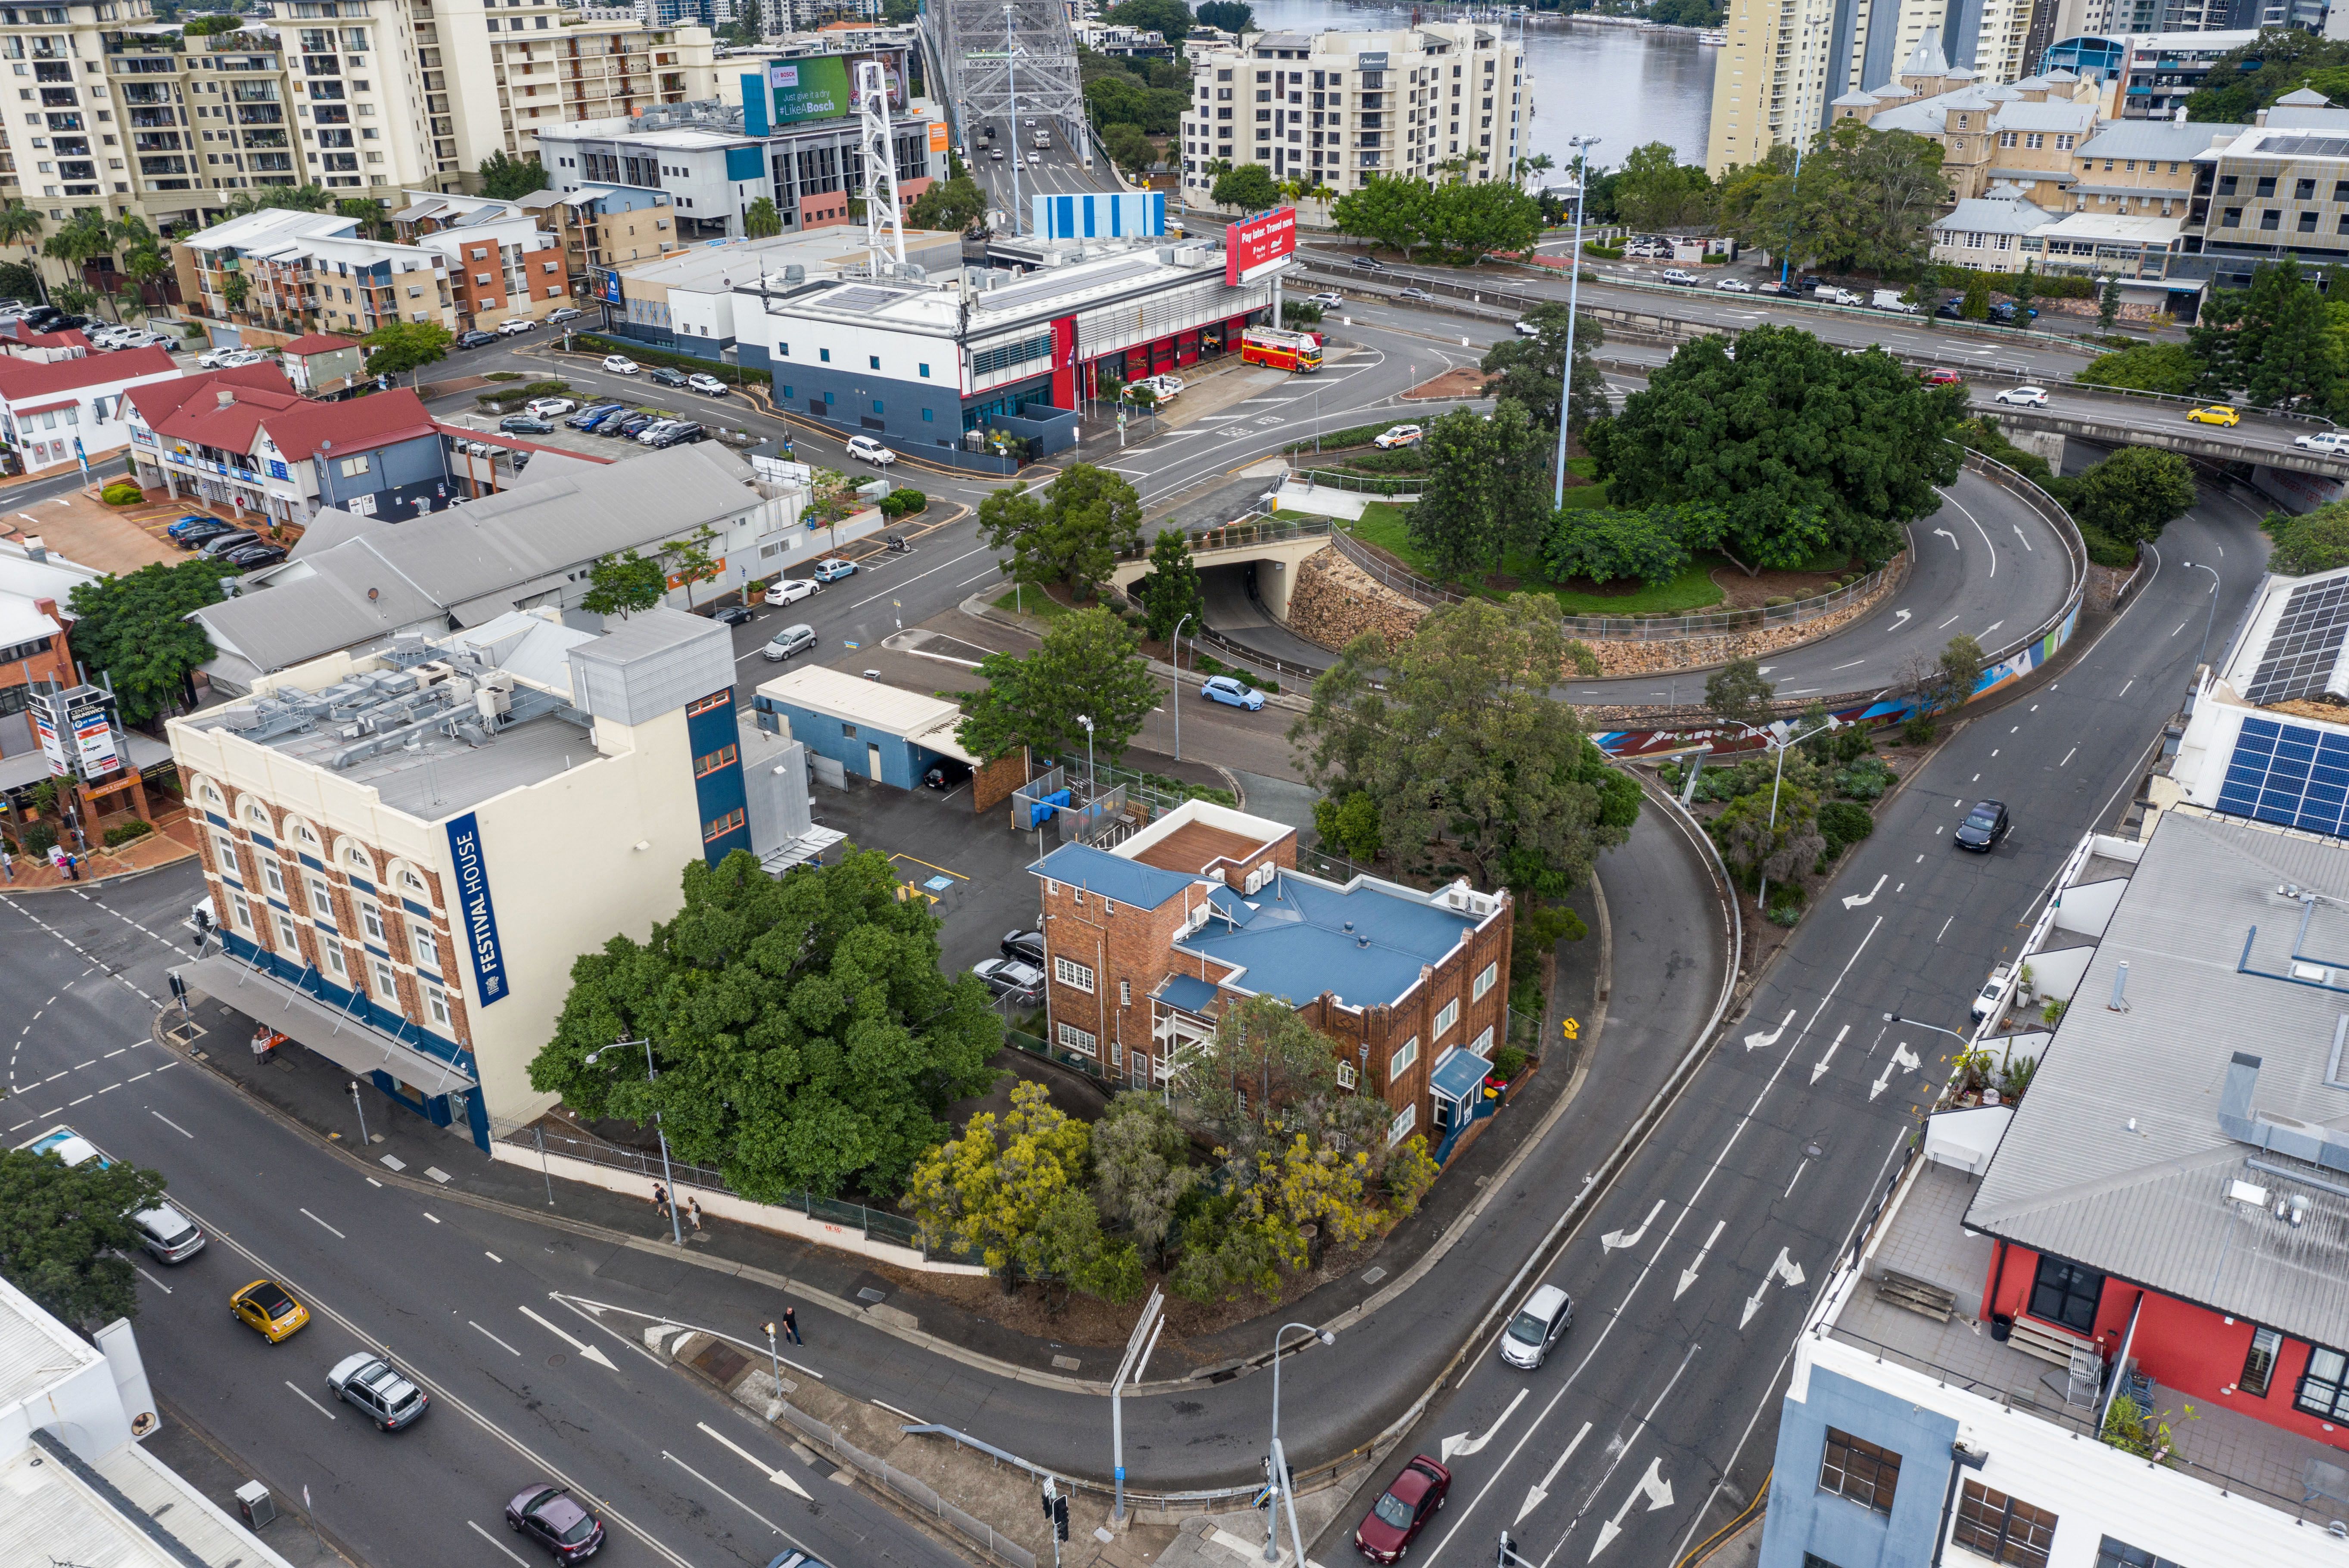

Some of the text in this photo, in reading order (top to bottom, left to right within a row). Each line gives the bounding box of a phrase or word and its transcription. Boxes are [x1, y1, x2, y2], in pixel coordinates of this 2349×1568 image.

[784, 93, 796, 102] Just
[797, 91, 809, 102] give
[810, 90, 814, 99] it
[820, 89, 830, 99] dry
[779, 100, 834, 116] #LikeABosch
[1241, 218, 1293, 244] Pay later. Travel now.
[1257, 245, 1266, 253] PayPal
[1252, 415, 1285, 425] KEEP
[1215, 426, 1254, 438] CLEAR
[70, 704, 96, 716] CENTRAL
[72, 706, 106, 721] BRUNSWICK
[457, 831, 482, 894] HOUSE
[469, 893, 497, 974] FESTIVAL
